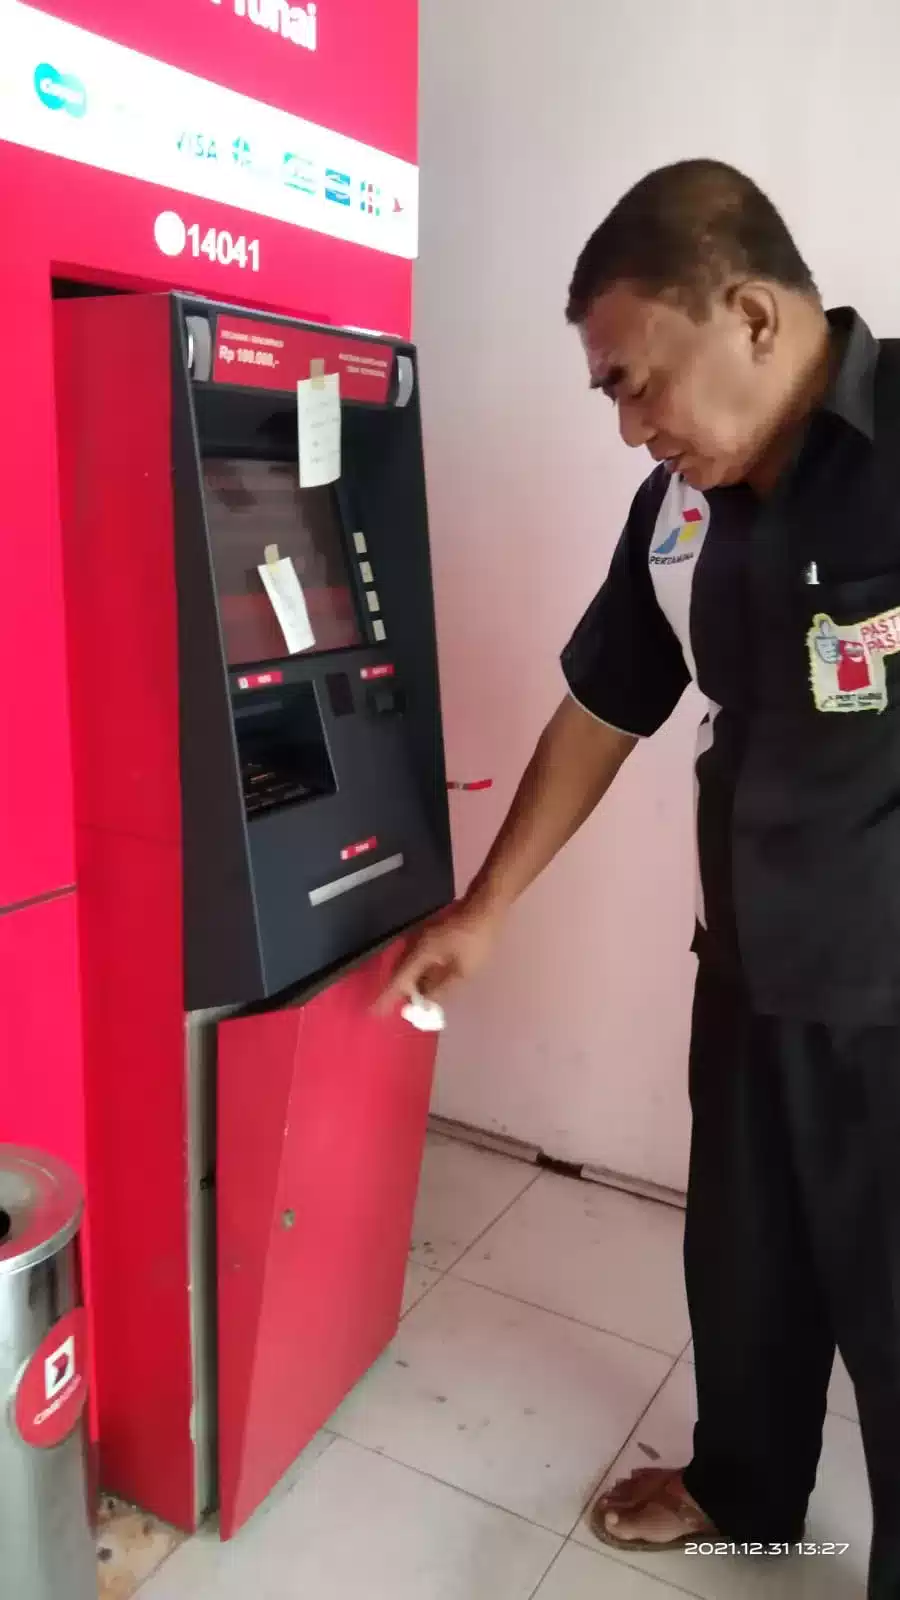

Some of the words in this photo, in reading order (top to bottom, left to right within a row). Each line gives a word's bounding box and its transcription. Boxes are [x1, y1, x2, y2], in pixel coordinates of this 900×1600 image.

[175, 131, 219, 161] VISA
[186, 223, 260, 272] 14041
[219, 344, 235, 364] Rp
